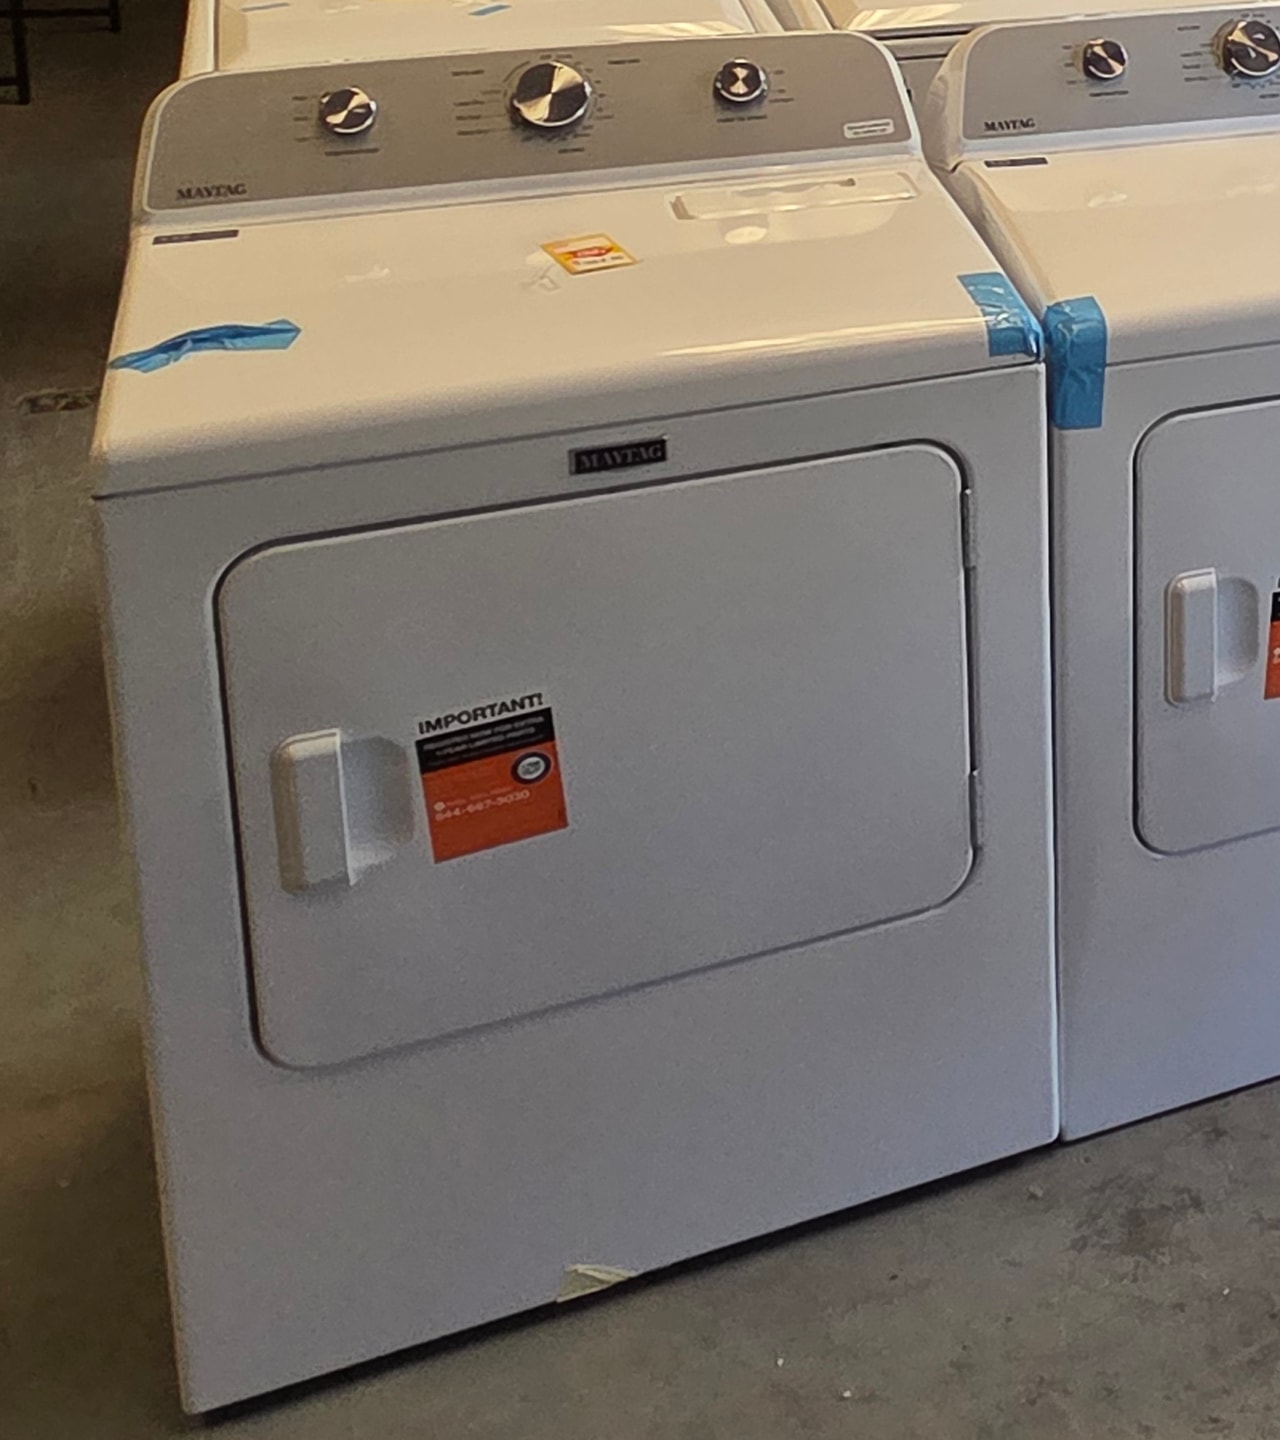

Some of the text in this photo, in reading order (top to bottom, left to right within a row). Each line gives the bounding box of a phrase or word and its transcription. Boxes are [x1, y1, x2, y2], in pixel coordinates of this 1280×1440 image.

[984, 118, 1035, 131] MAYTAG
[176, 183, 247, 201] MAYTAG
[581, 444, 663, 469] MAYTAG
[418, 692, 544, 735] IMPORTANT!
